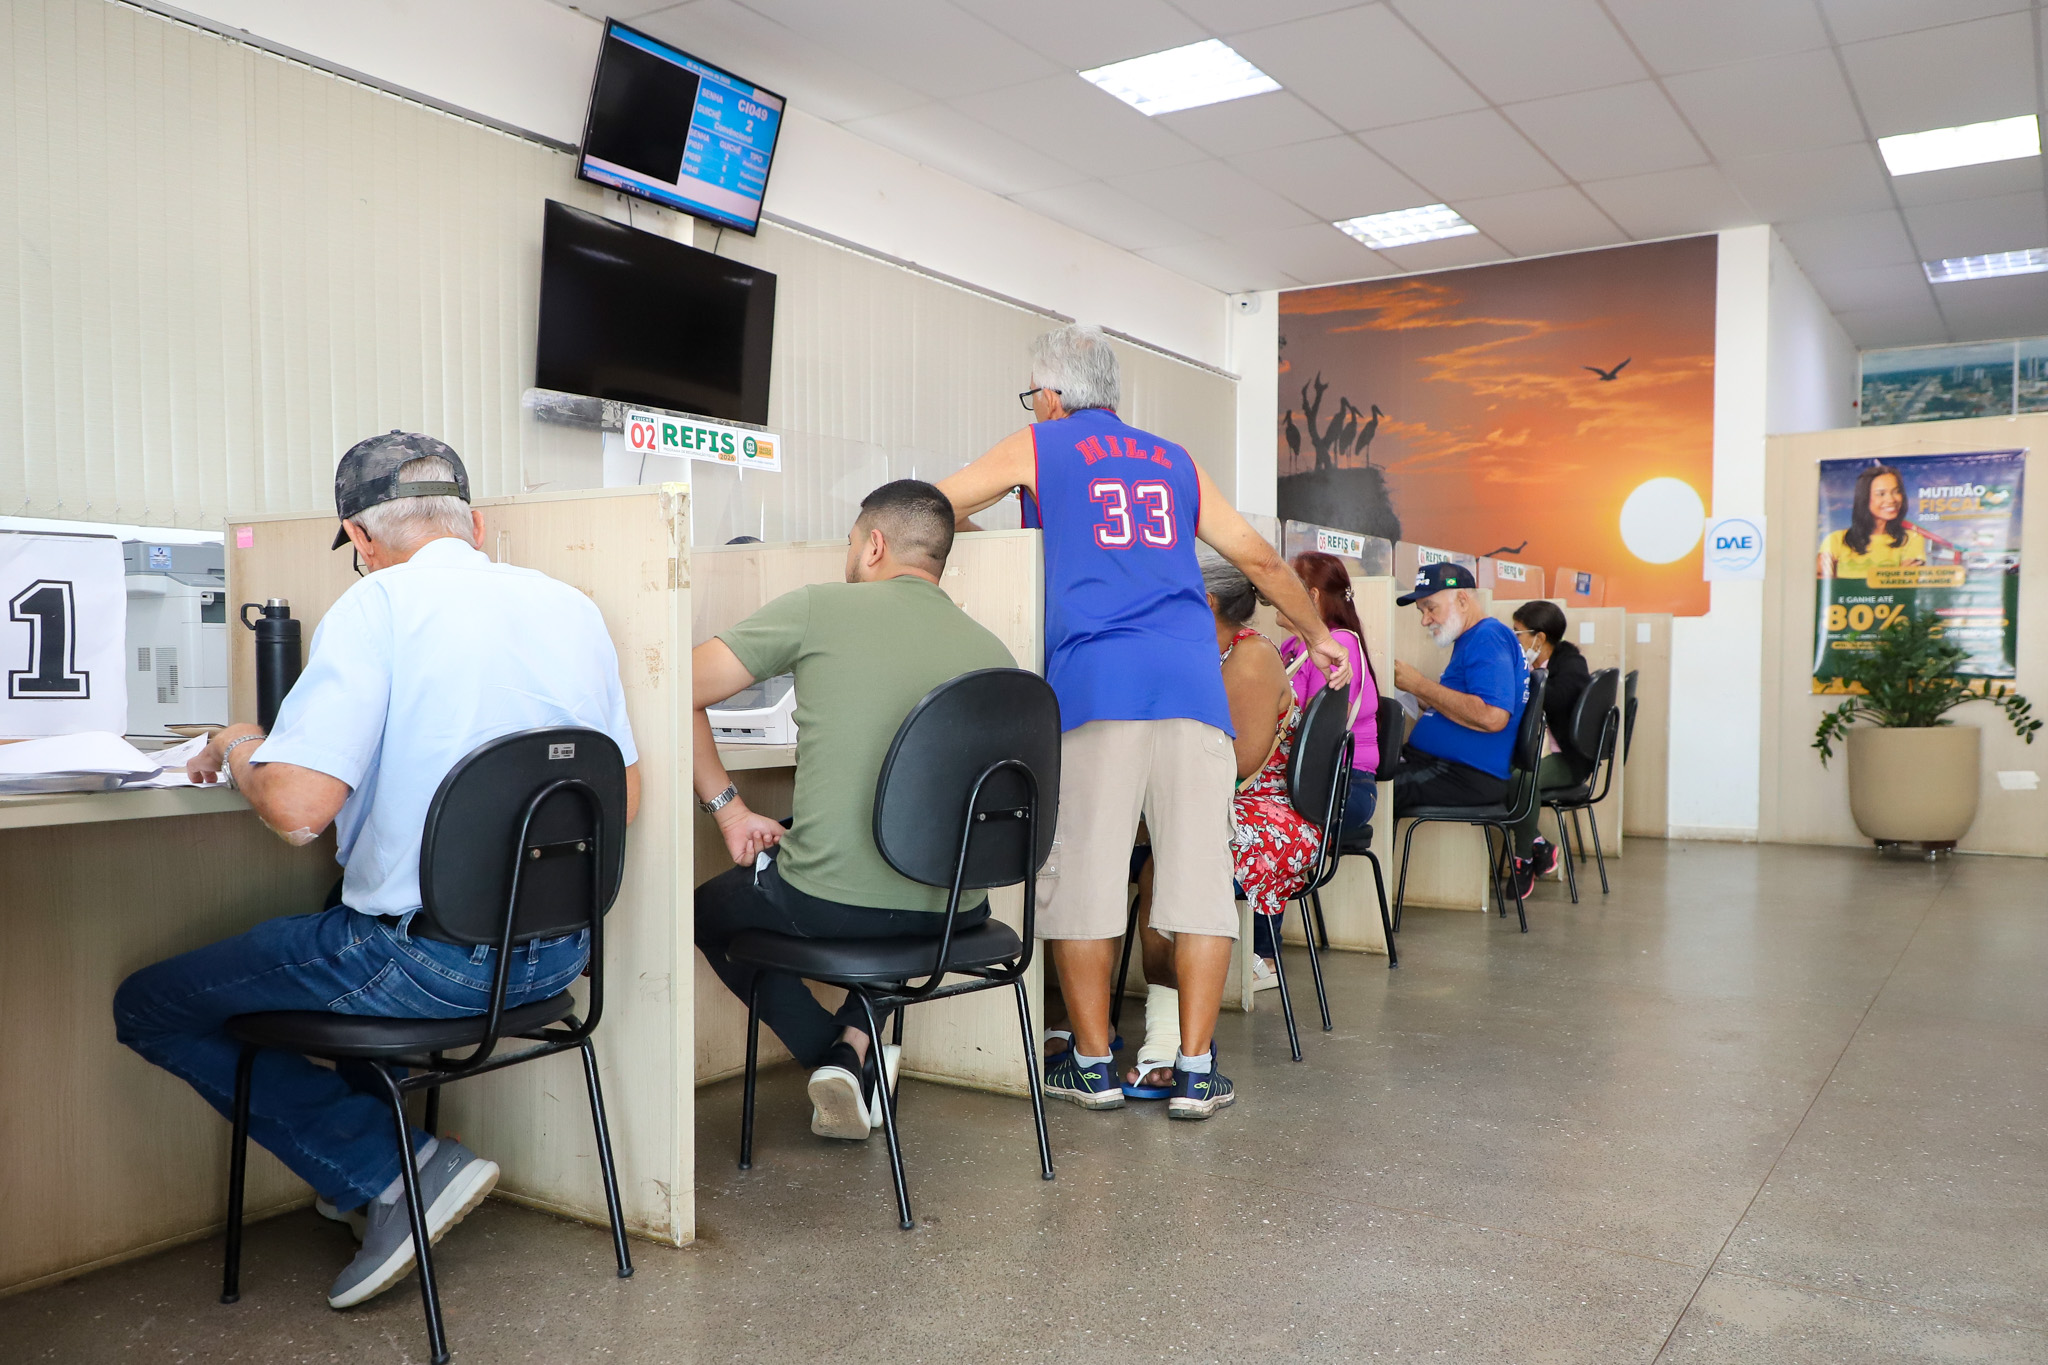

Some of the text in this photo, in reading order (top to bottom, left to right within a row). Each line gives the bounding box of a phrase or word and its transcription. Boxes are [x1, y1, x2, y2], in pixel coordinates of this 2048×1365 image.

[701, 88, 768, 121] SENHA CI049
[745, 120, 754, 133] 2
[631, 422, 656, 450] 02
[662, 422, 735, 454] REFIS
[720, 453, 735, 461] 2026
[1075, 435, 1173, 469] HILL
[1918, 483, 1986, 498] MUTIRÃO
[1088, 478, 1178, 550] 33
[1918, 497, 1985, 513] FISCAL
[1327, 535, 1349, 550] REFIS
[1716, 536, 1752, 550] DAE
[1877, 595, 1894, 603] ATÉ
[1823, 604, 1909, 631] 80%
[8, 579, 90, 700] 1
